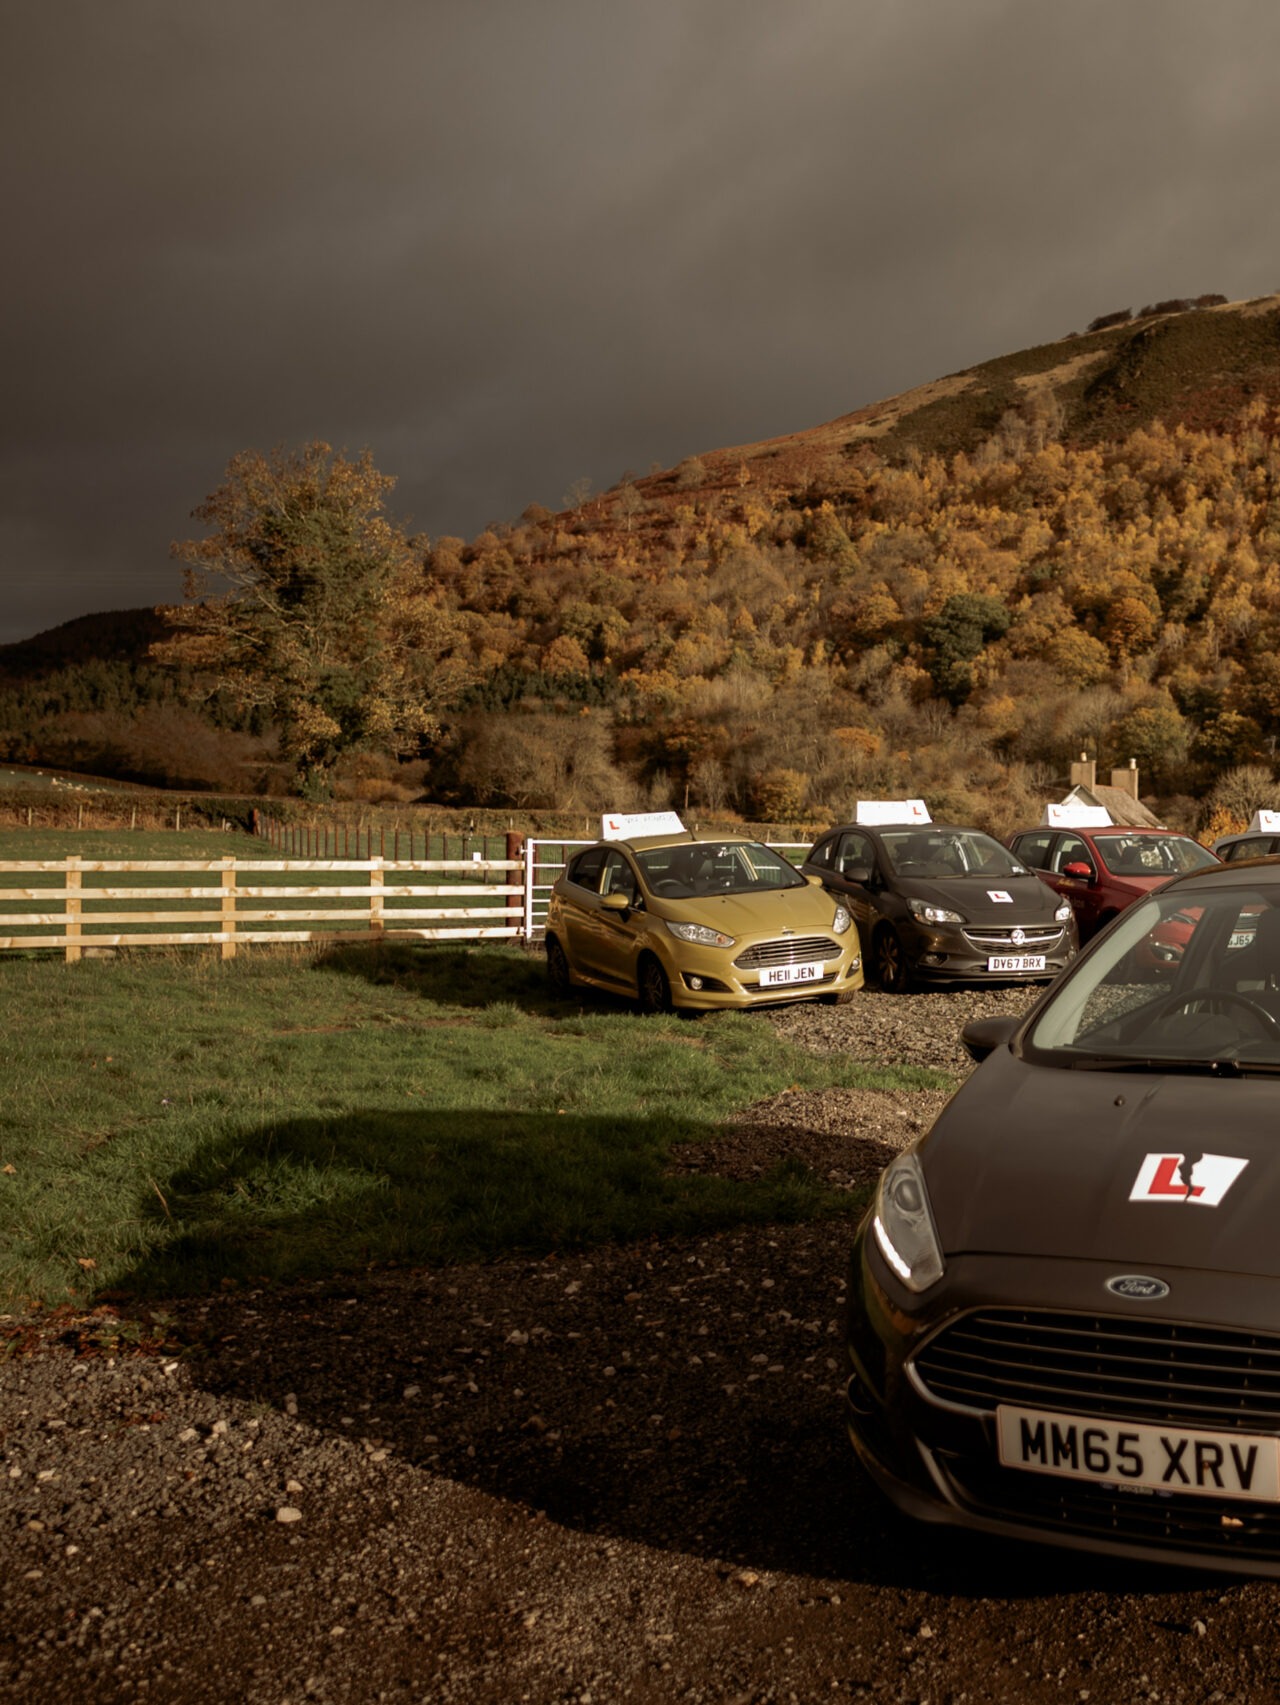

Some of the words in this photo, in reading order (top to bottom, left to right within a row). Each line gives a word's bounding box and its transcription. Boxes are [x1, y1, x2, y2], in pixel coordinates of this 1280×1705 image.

[913, 806, 922, 815] L
[609, 820, 620, 830] L
[794, 966, 815, 980] JEN
[1148, 1157, 1206, 1197] L
[1120, 1279, 1156, 1295] Ford
[1020, 1416, 1144, 1479] MM65
[1160, 1436, 1259, 1491] XRV
